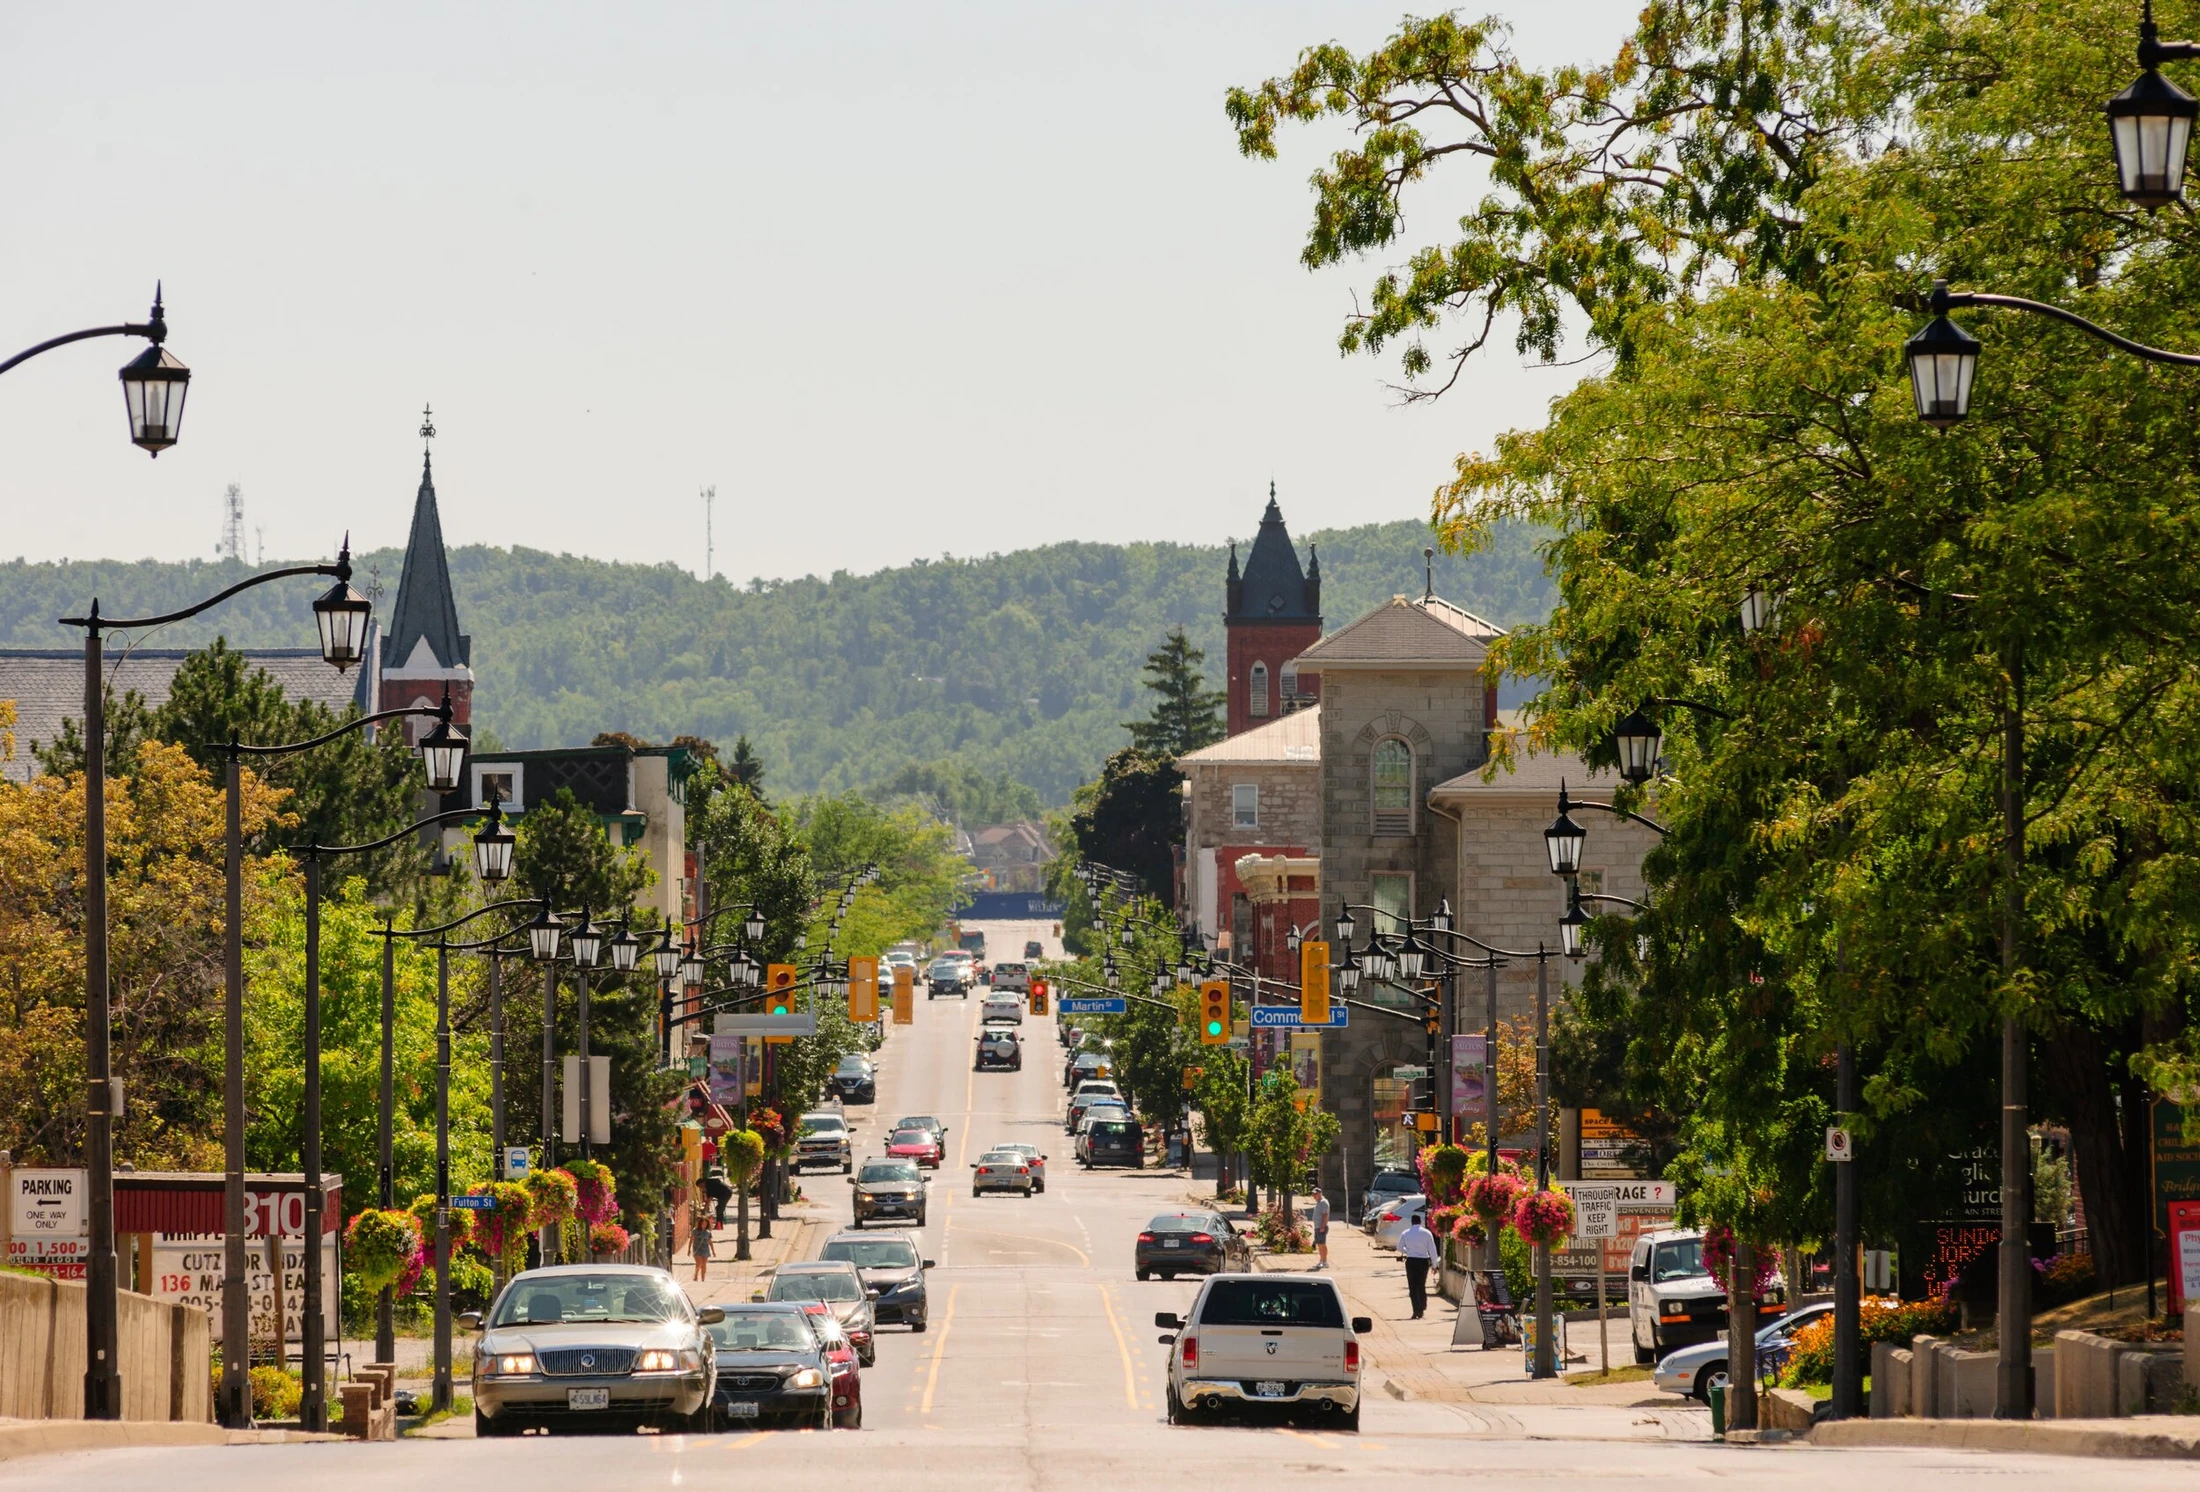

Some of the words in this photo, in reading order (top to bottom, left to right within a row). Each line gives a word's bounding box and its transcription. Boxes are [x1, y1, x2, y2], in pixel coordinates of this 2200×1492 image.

[1071, 1001, 1105, 1011] Martin
[1253, 1009, 1335, 1023] Commel
[1337, 1009, 1345, 1018] St
[22, 1179, 72, 1195] PARKING
[1578, 1189, 1614, 1201] THROUGH
[1615, 1187, 1647, 1200] RAGE
[453, 1198, 479, 1207] Fulton
[483, 1198, 492, 1207] St
[1581, 1201, 1612, 1213] TRAFFIC
[26, 1211, 45, 1220] ONE
[49, 1211, 67, 1220] WAY
[1587, 1213, 1607, 1224] KEEP
[35, 1220, 58, 1229] ONLY
[1586, 1224, 1609, 1235] RIGHT
[1937, 1228, 2003, 1245] SUNDA
[37, 1241, 77, 1256] 1,500
[183, 1253, 221, 1271] CUTZ
[161, 1275, 191, 1292] 136
